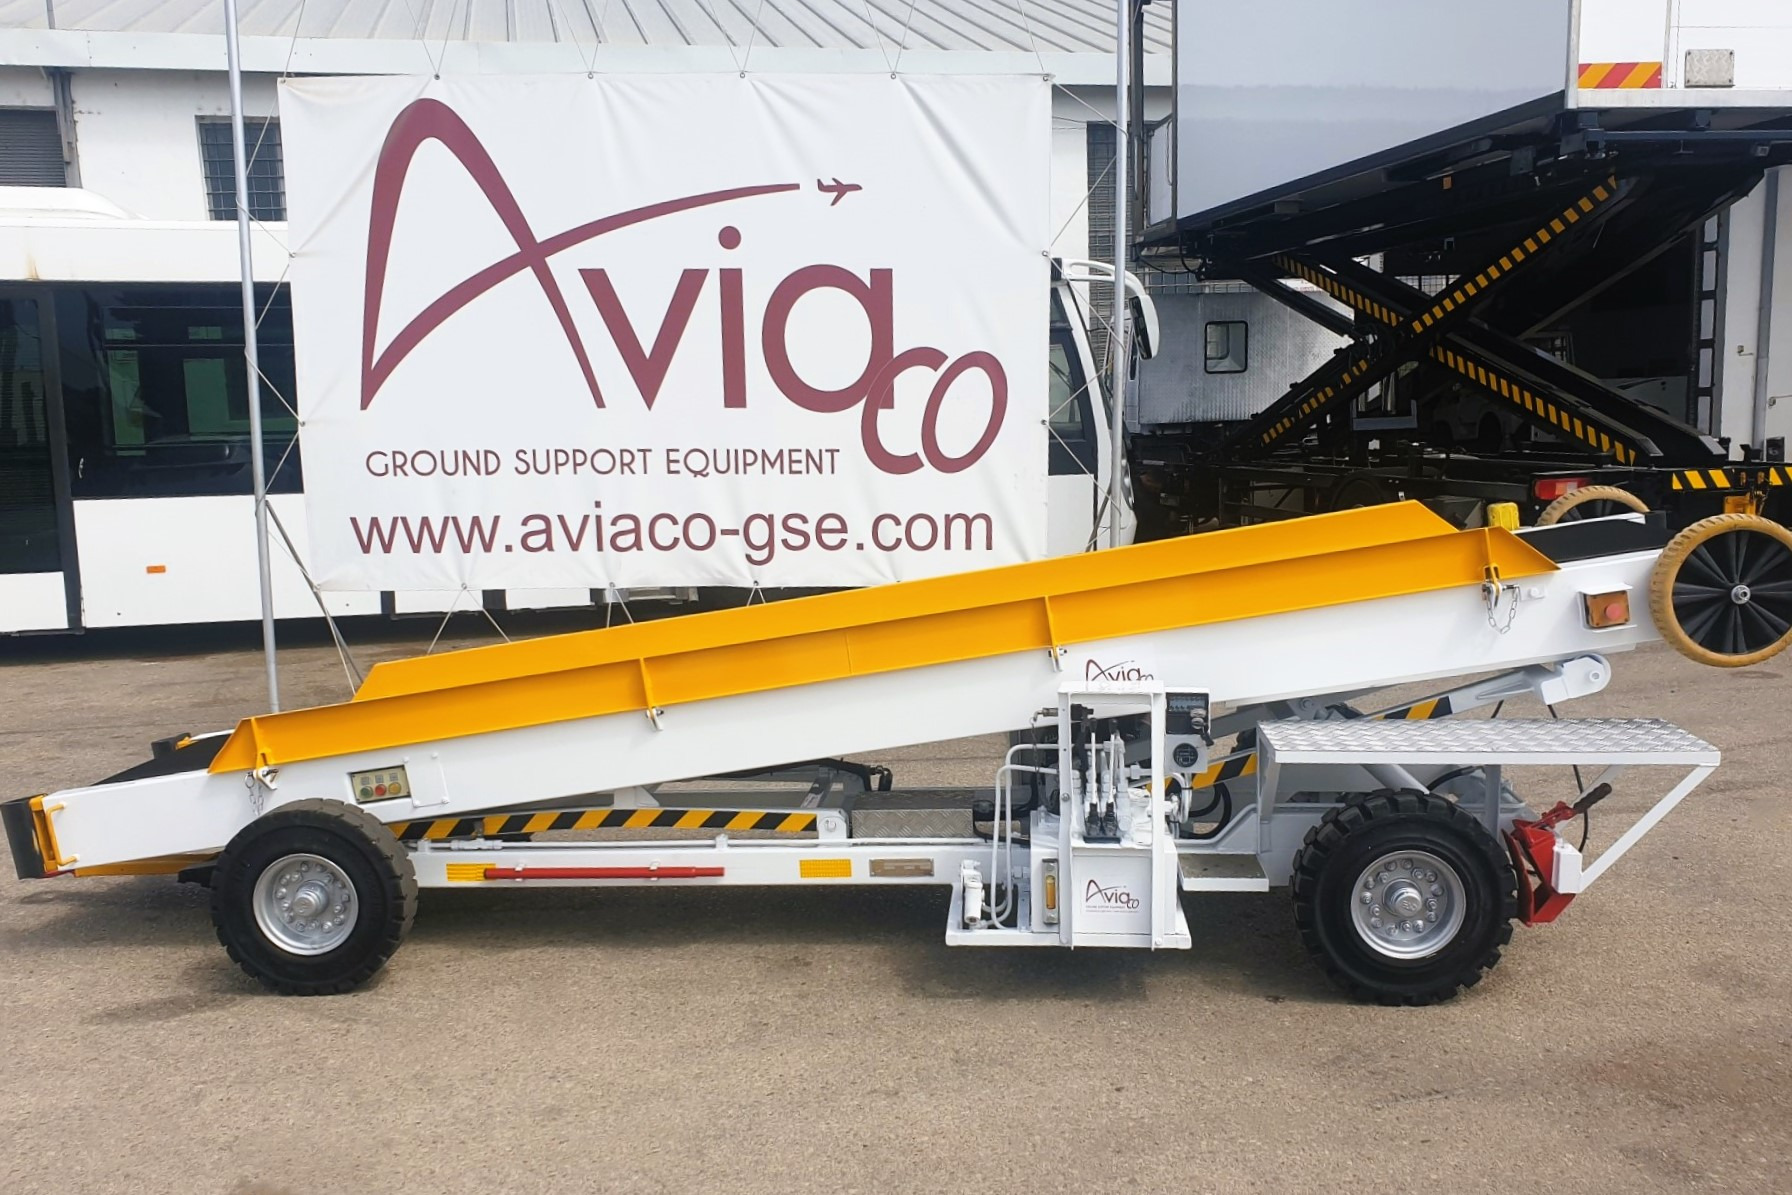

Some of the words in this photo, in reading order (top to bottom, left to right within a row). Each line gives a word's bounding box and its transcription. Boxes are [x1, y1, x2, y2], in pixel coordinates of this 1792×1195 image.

[366, 450, 501, 477] GROUND
[514, 448, 652, 476] SUPPORT
[666, 448, 840, 478] EQUIPMENT
[350, 502, 993, 566] www.aviaco-gse.com
[1086, 879, 1140, 909] Aviaco
